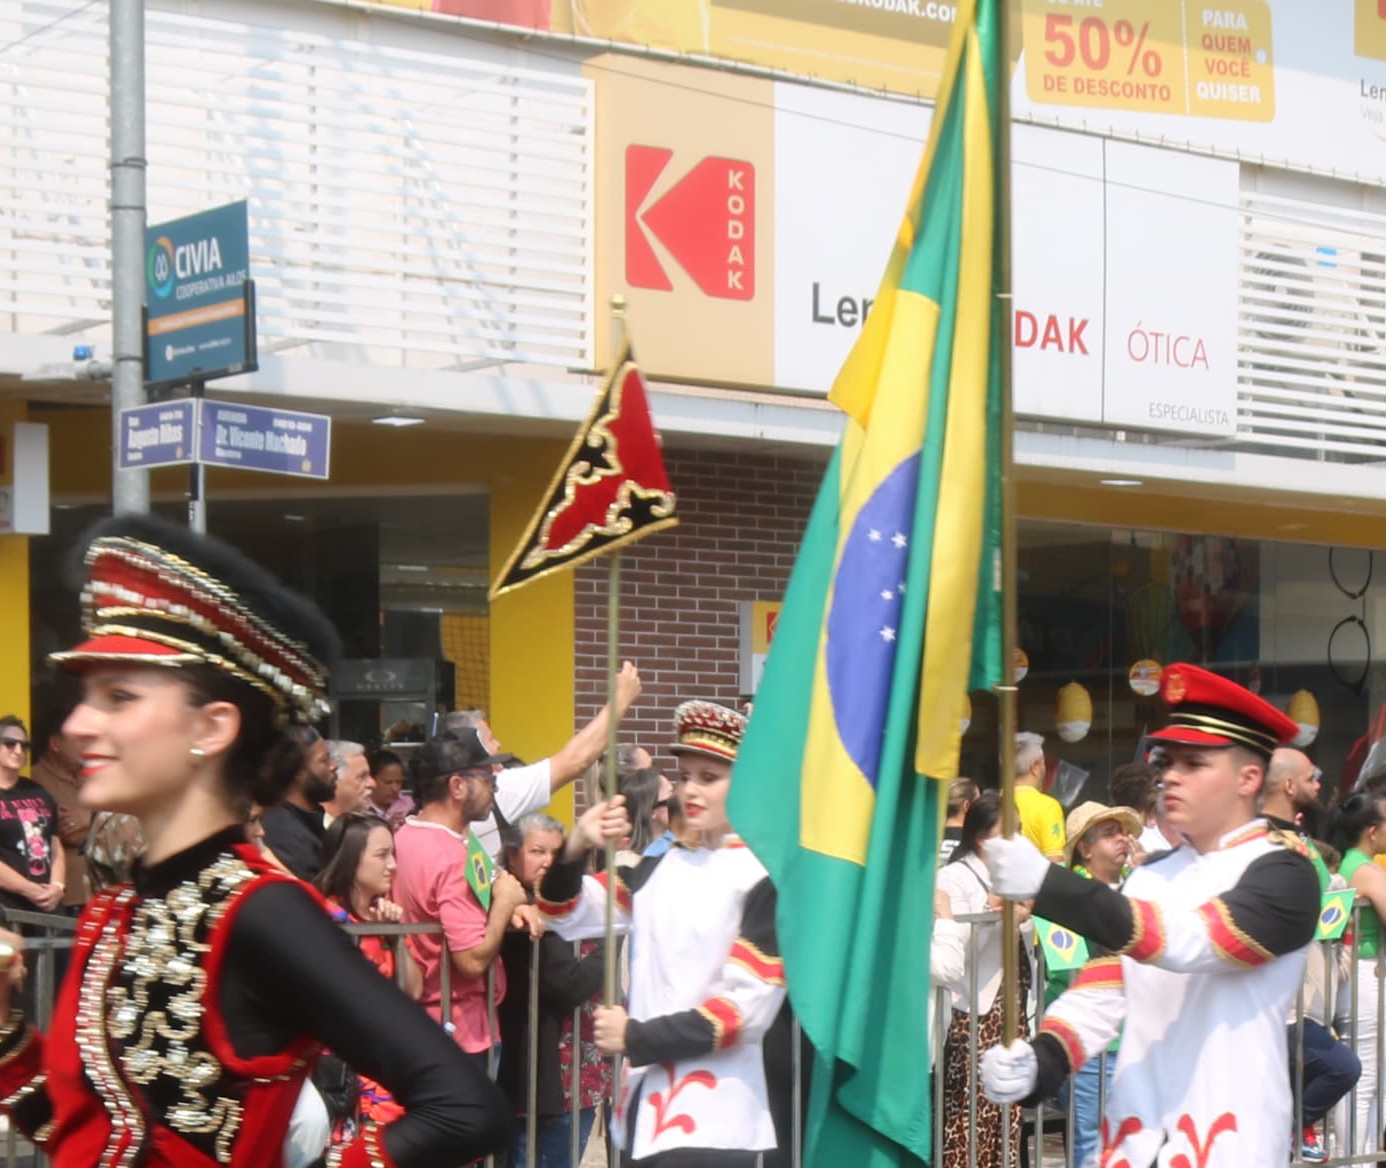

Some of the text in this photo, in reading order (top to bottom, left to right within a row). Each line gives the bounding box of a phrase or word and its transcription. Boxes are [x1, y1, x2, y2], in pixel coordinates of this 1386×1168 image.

[1201, 9, 1248, 30] PARA
[1044, 12, 1163, 78] 50%
[1201, 33, 1252, 53] QUEM
[1204, 57, 1251, 78] VOCÊ
[1043, 74, 1171, 102] DE DESCONTO
[1196, 81, 1261, 104] QUISER
[727, 169, 745, 291] KODAK
[175, 237, 222, 278] CIVIA
[1127, 320, 1210, 370] ÓTICA
[1149, 402, 1230, 425] ESPECIALISTA
